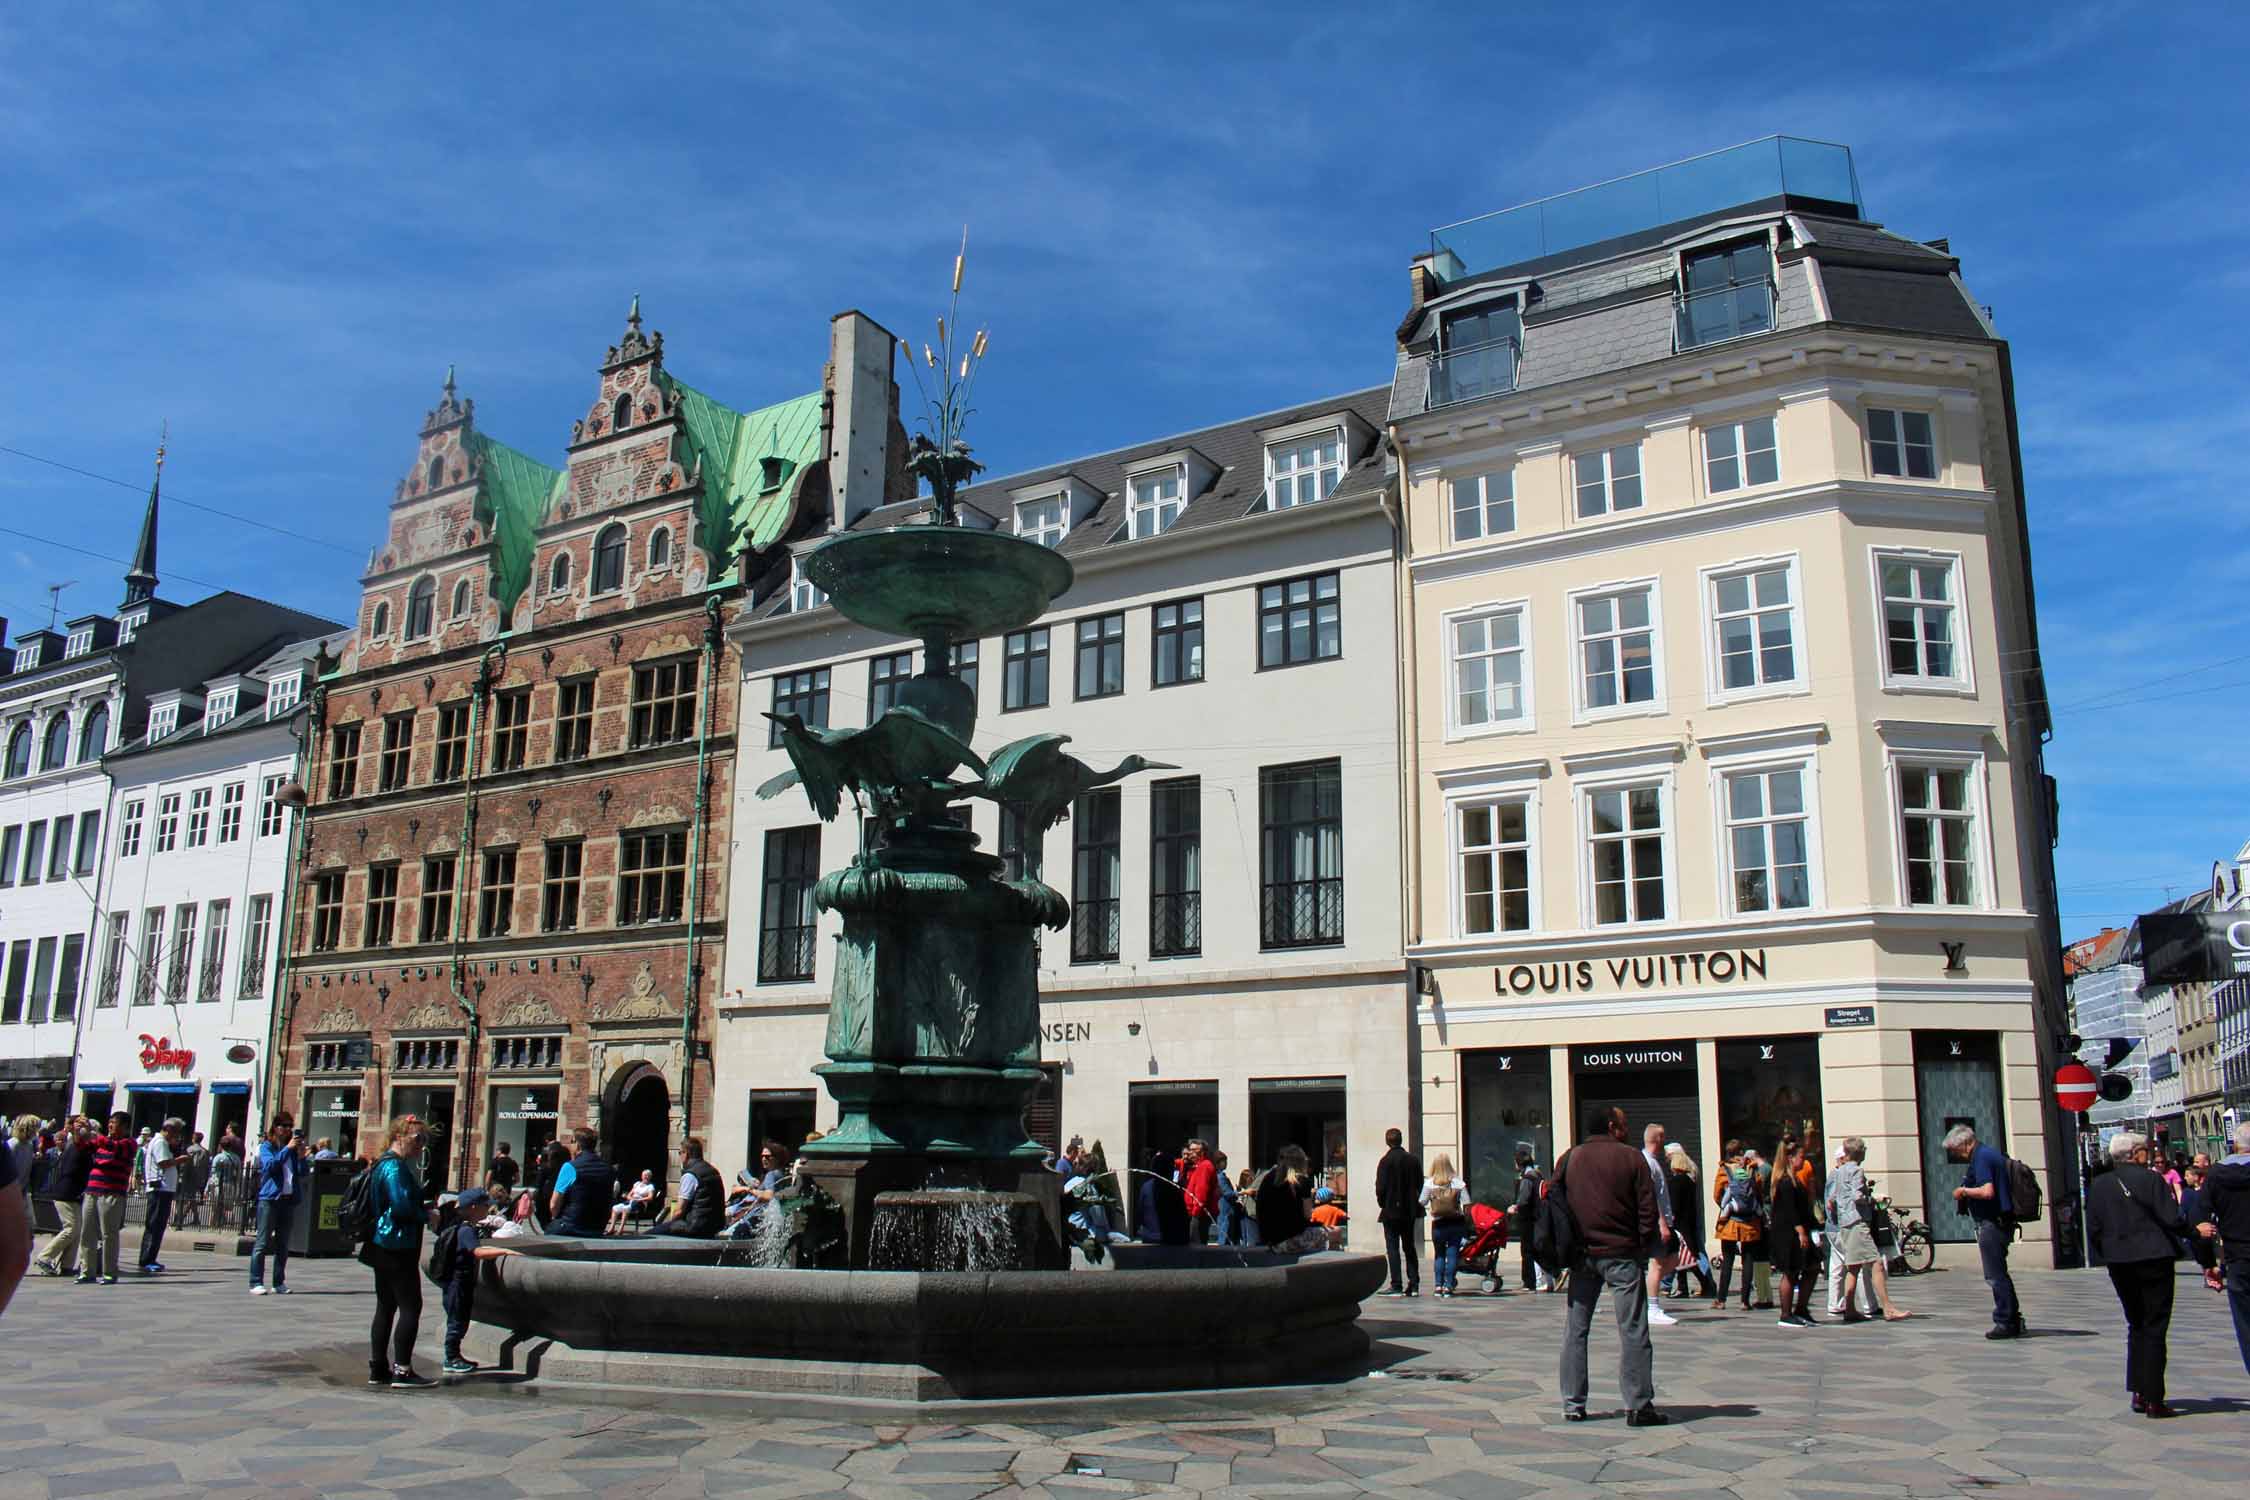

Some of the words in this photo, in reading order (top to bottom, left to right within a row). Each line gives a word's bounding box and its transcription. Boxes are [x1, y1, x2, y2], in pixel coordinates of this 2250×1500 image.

[400, 956, 581, 982] COPNHAGEN
[1494, 961, 1593, 994] LOUIS
[1607, 949, 1767, 988] VUITTON
[1583, 1054, 1621, 1066] LOUIS
[1625, 1051, 1683, 1064] VUITTON
[519, 1111, 559, 1119] COPENHAGEN
